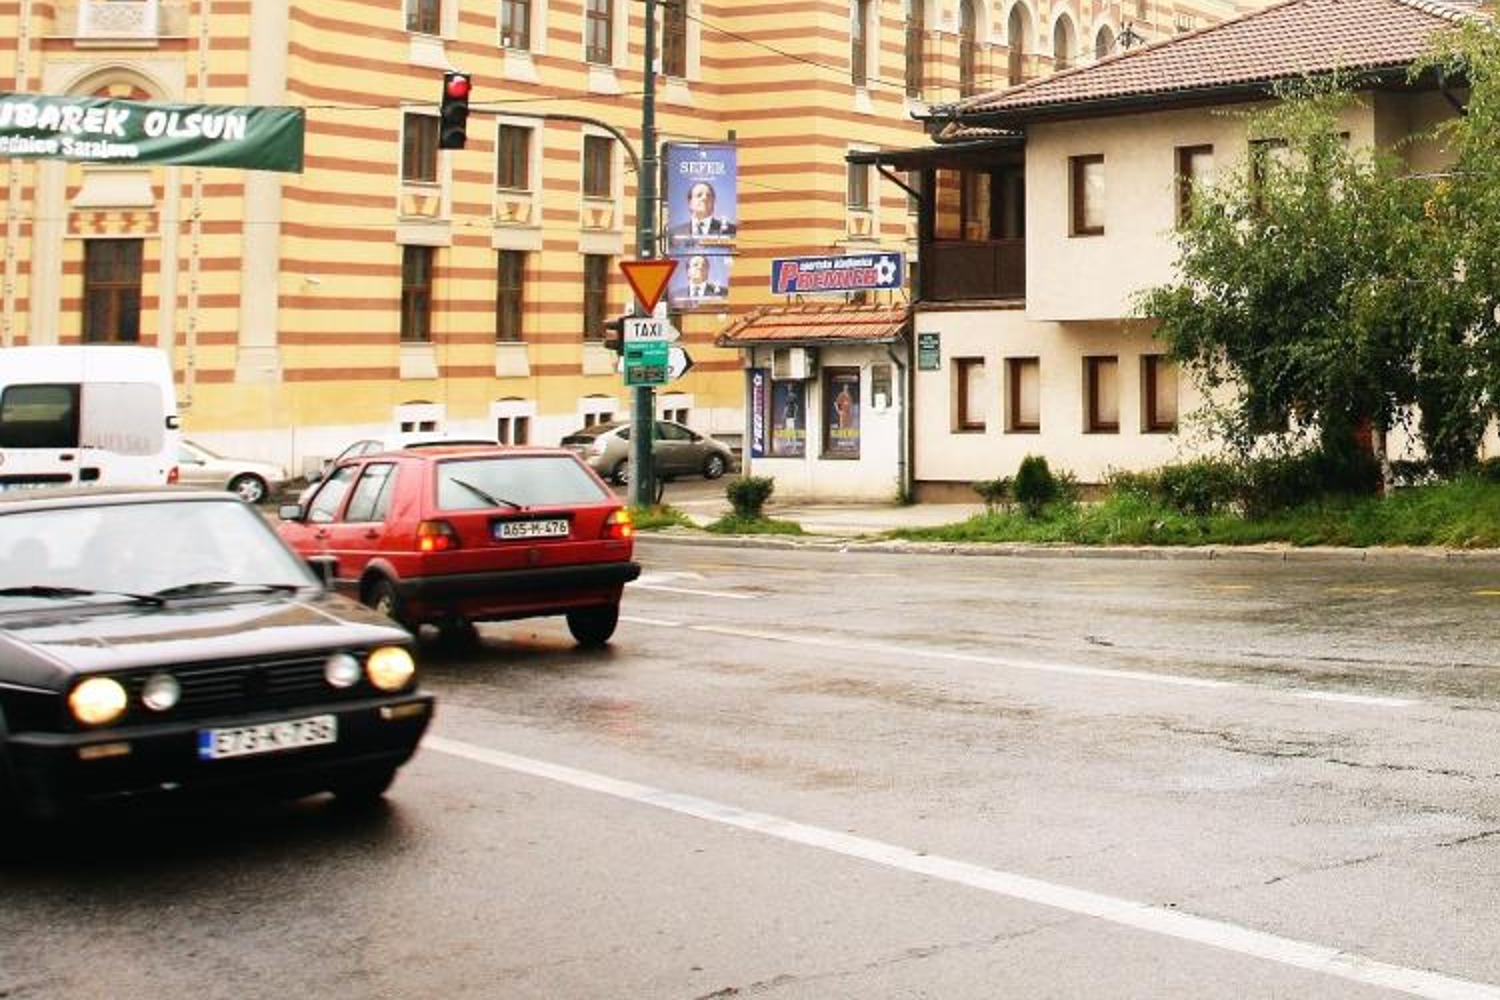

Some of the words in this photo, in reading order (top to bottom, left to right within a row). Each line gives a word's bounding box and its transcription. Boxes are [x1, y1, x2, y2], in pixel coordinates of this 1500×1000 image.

[144, 111, 247, 139] OLSUN
[679, 161, 726, 174] SEFER
[634, 322, 663, 337] TAXI
